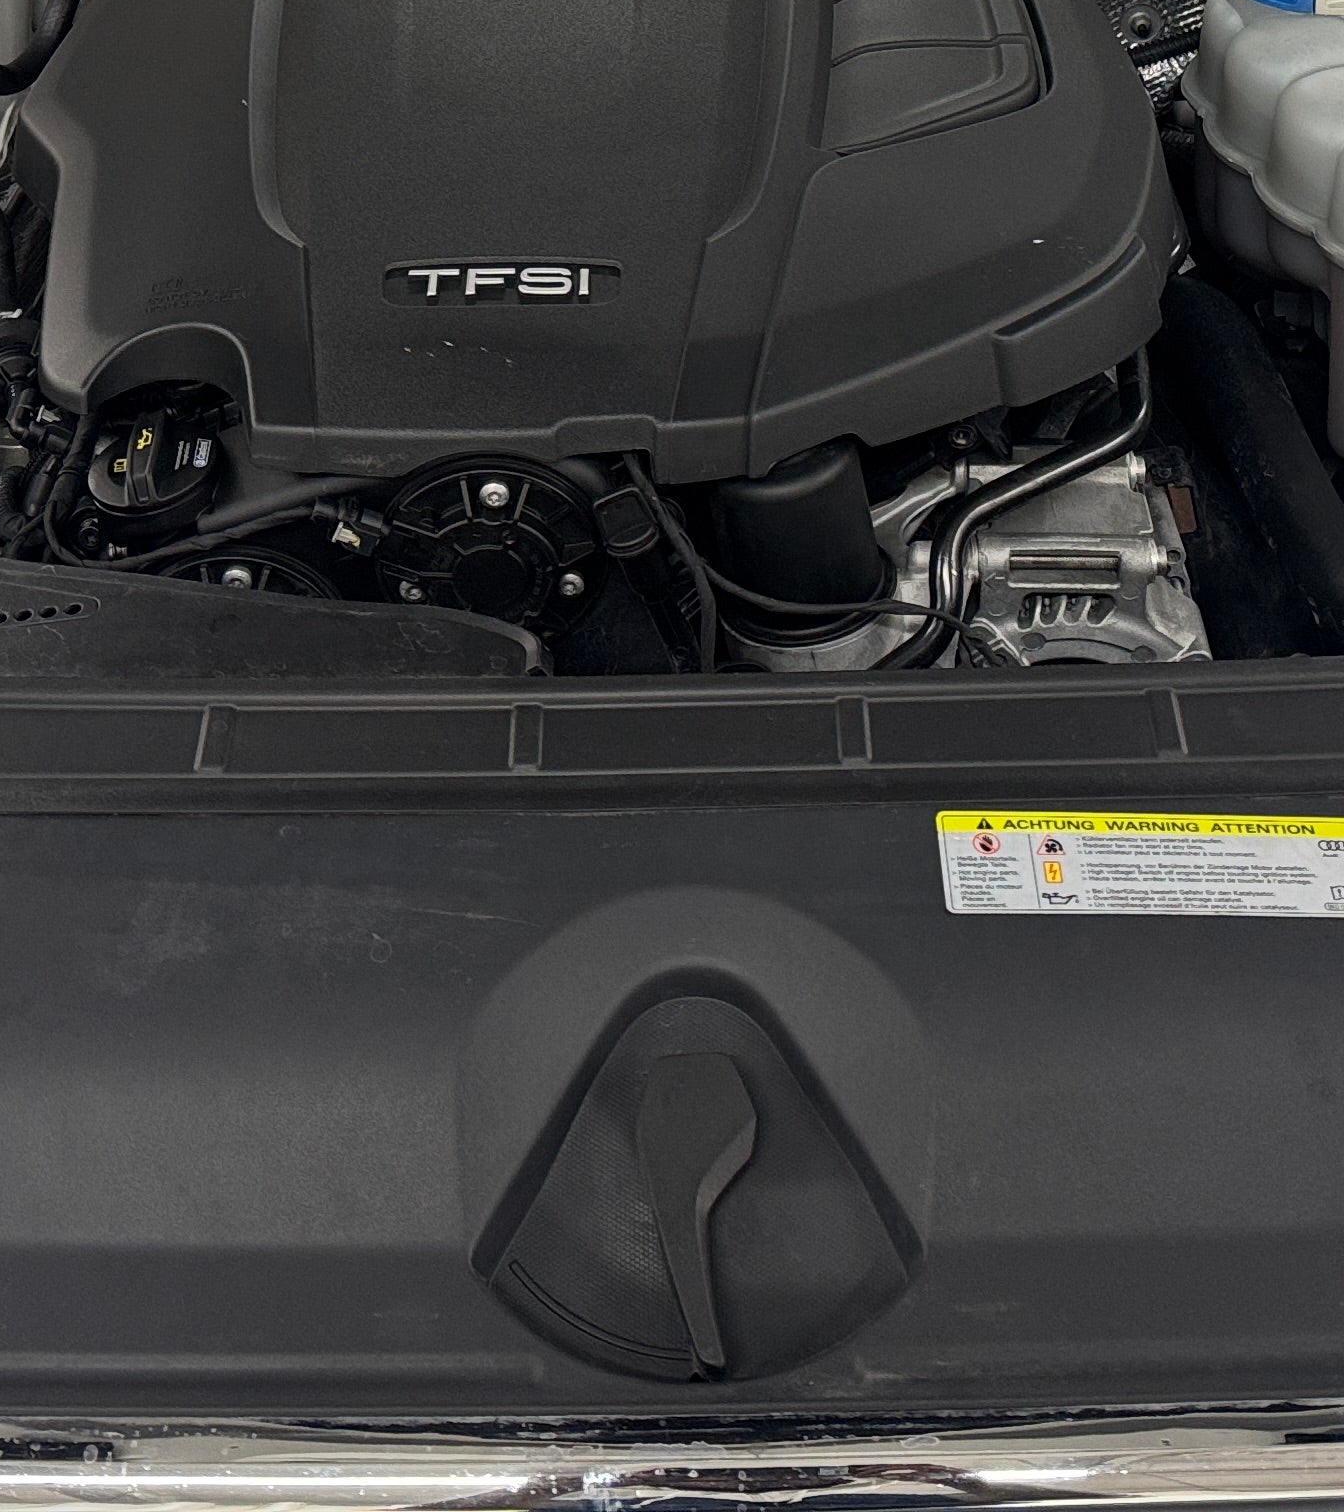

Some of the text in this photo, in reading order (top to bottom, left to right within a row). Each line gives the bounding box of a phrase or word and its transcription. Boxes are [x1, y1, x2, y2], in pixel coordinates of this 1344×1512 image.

[407, 267, 589, 297] TFSI
[1002, 818, 1314, 834] ACHTUNG WARNING ATTENTION
